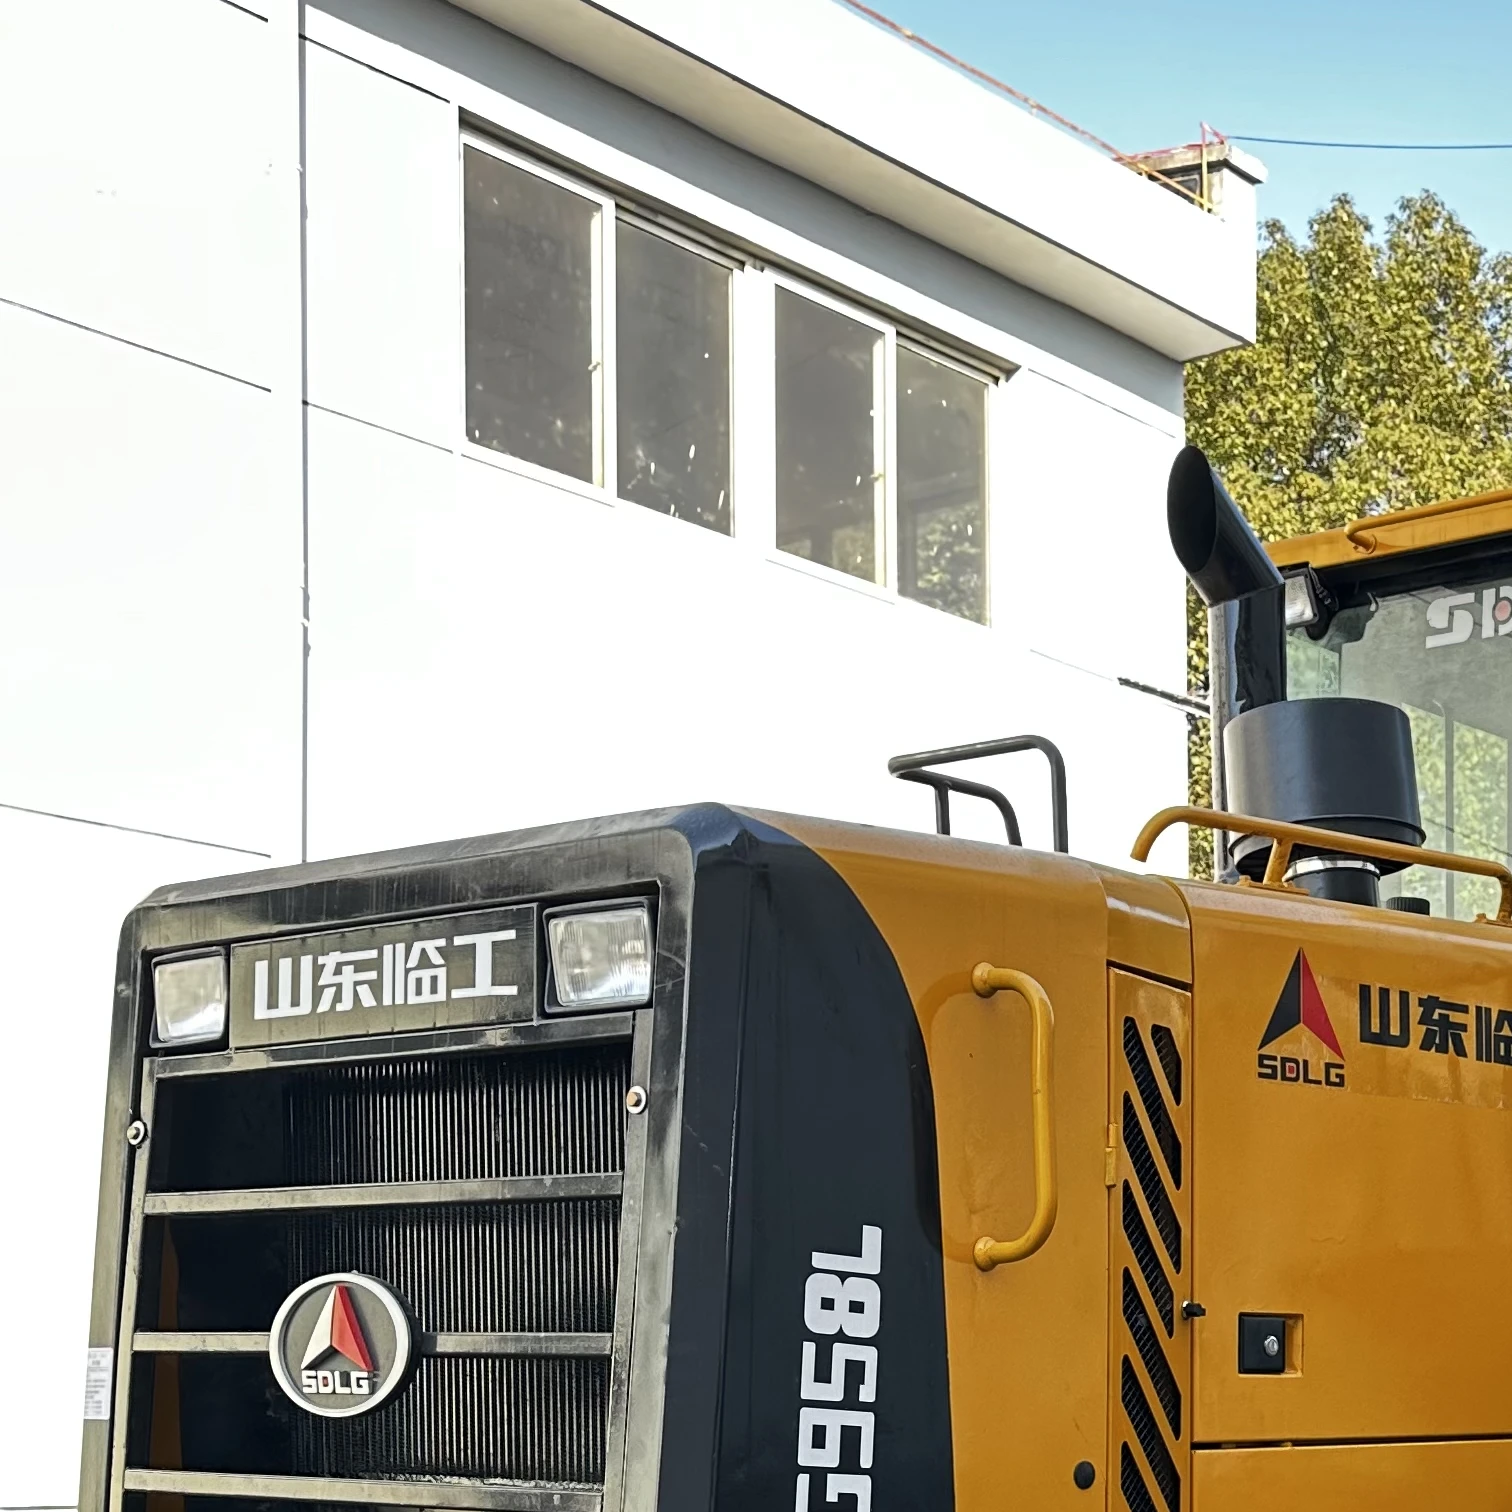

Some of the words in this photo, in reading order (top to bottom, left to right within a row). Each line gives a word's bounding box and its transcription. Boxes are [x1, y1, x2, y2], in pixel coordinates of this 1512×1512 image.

[254, 929, 518, 1020] 山东临工
[1257, 1053, 1345, 1088] SDLG
[301, 1370, 370, 1395] SDLG
